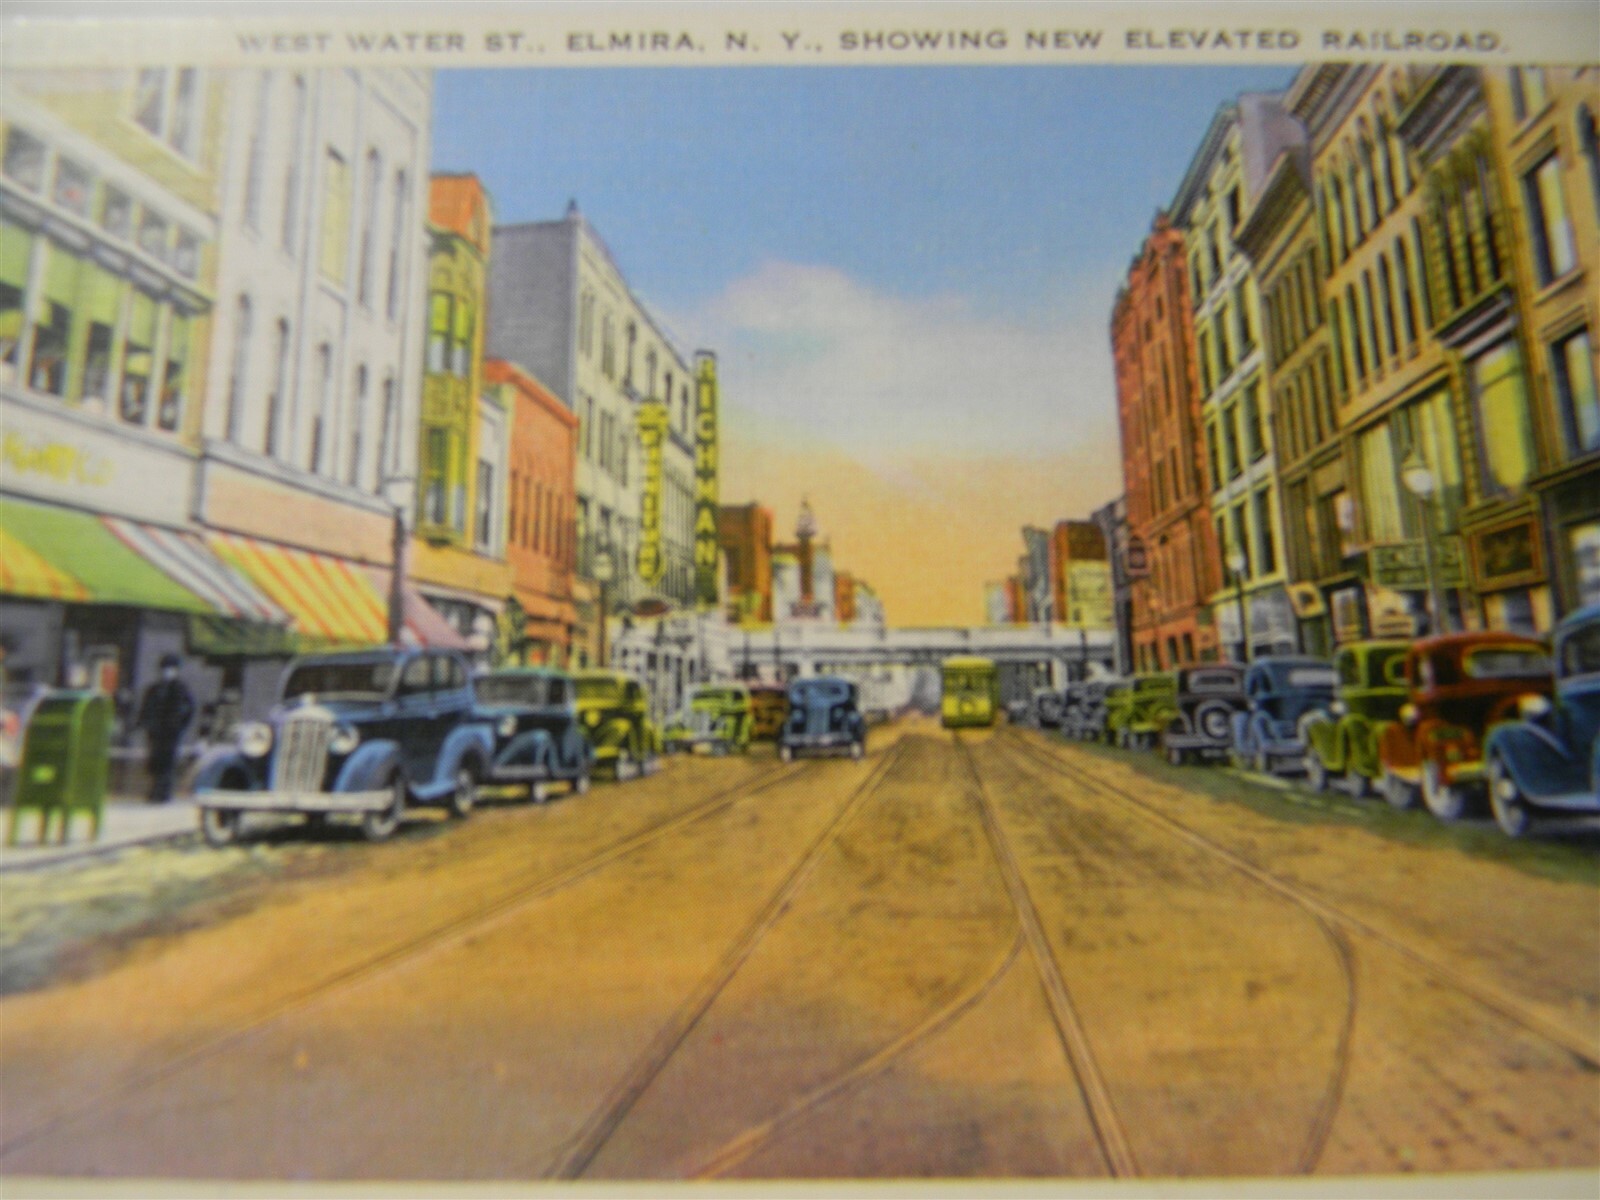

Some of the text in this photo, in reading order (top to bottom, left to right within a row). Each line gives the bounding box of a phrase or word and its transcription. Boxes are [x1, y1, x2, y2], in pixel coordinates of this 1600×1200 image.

[236, 32, 332, 52] WEST
[347, 32, 466, 52] WATER
[724, 32, 760, 52] N.
[838, 31, 1009, 50] SHOWING
[1024, 31, 1104, 50] NEW
[1124, 29, 1302, 50] ELEVATED
